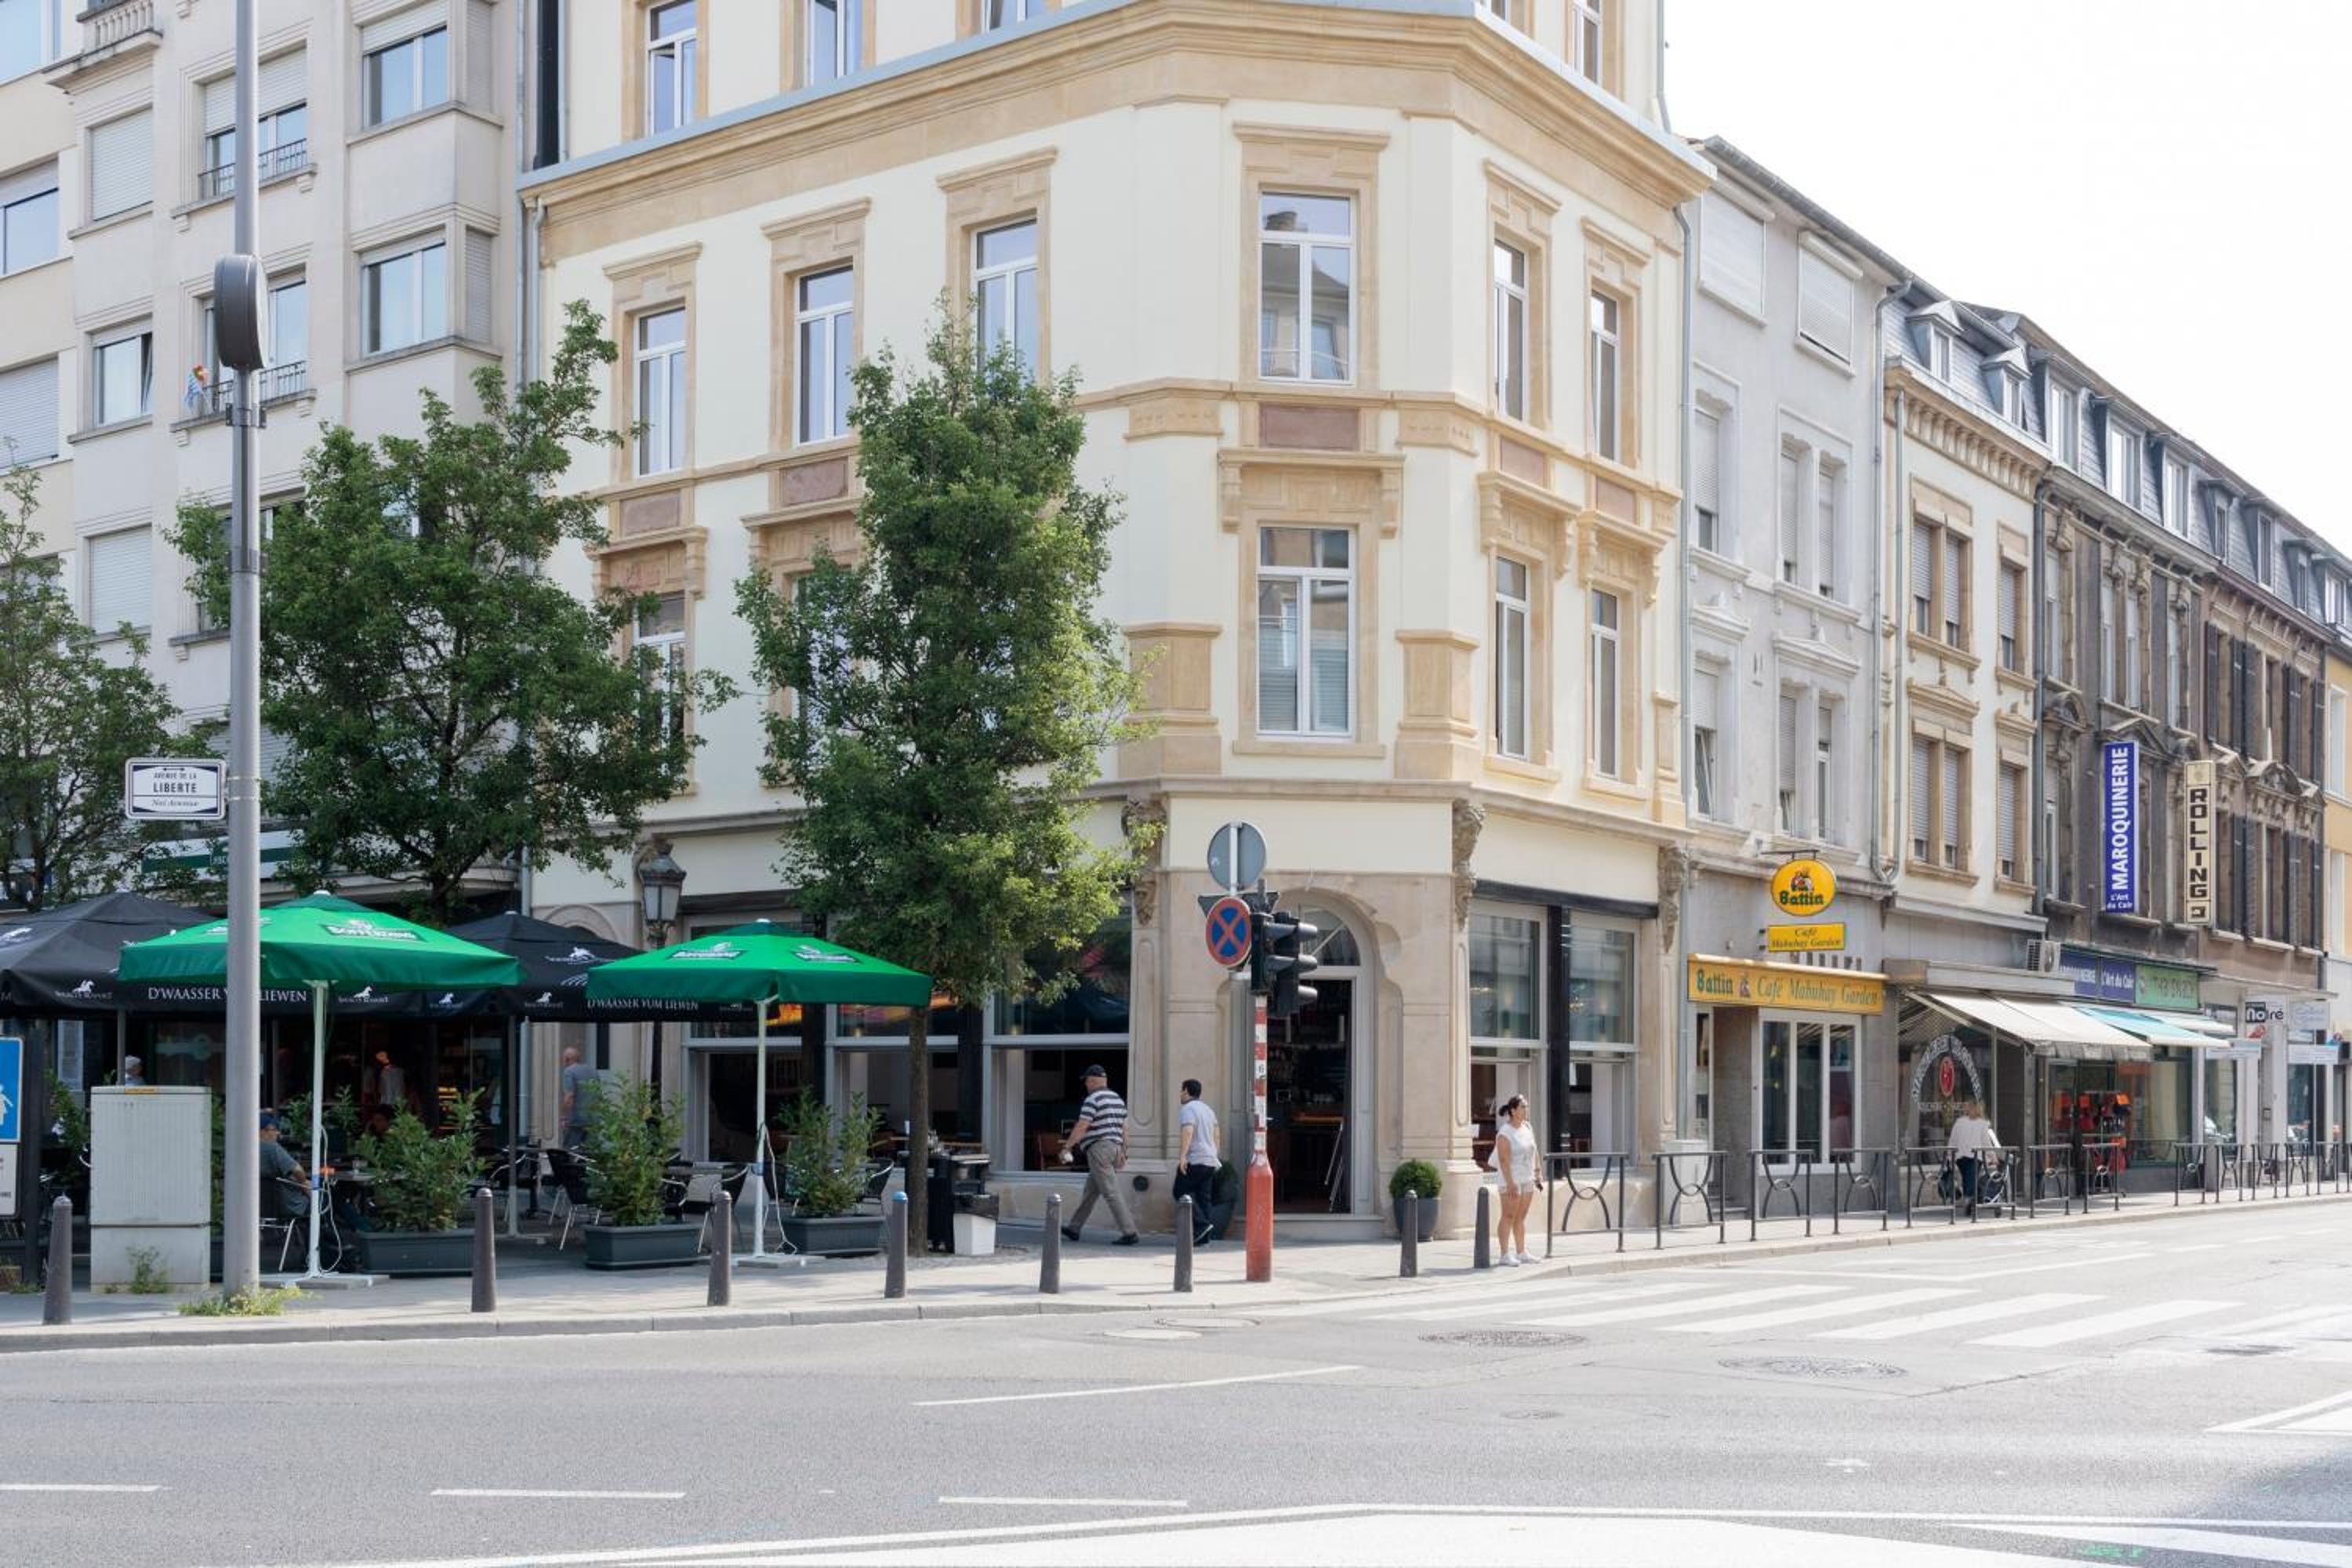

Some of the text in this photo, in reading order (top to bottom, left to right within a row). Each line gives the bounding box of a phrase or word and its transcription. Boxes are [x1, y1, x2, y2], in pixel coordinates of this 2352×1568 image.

[2111, 746, 2131, 890] MAROQUINERIE
[2189, 787, 2209, 898] ROLLING
[1779, 890, 1824, 905] Battin
[147, 986, 221, 1000] D'WAASSER
[1696, 968, 1733, 995] Battin
[1757, 975, 1783, 1003] Café
[1842, 983, 1878, 1005] Garden
